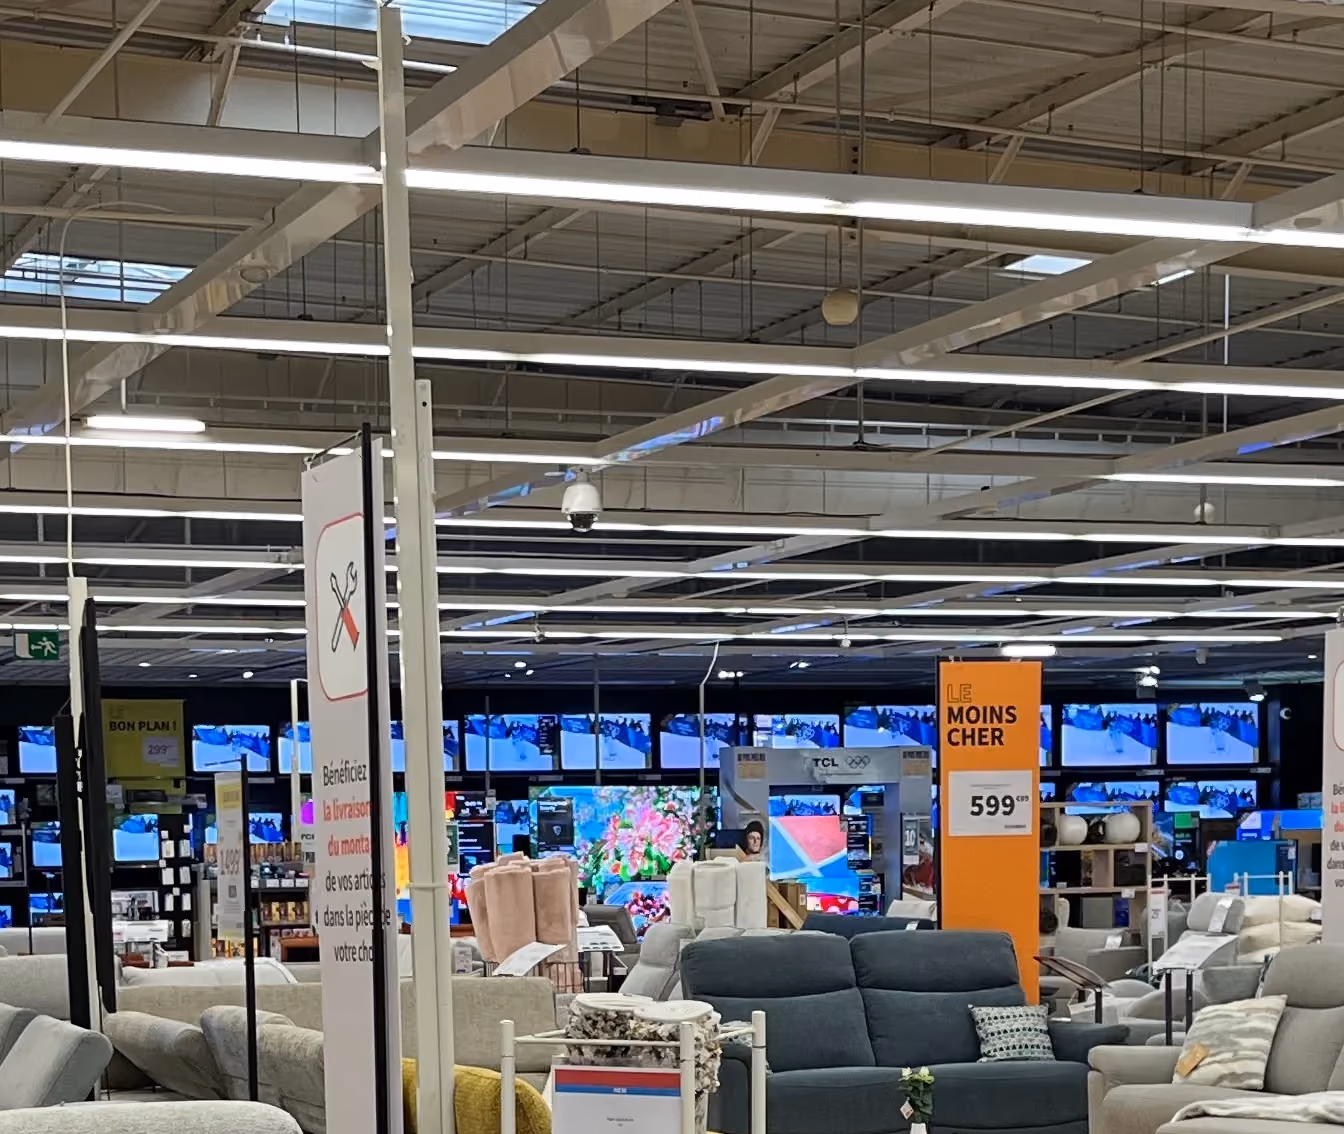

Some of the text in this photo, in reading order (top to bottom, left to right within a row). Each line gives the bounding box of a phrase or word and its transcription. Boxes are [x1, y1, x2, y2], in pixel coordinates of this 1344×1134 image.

[947, 683, 972, 703] LE
[947, 705, 1017, 724] MOINS
[109, 721, 170, 731] BON PLAN
[947, 727, 1004, 747] CHER
[323, 759, 367, 787] Bénéficiez
[812, 757, 839, 768] TCL
[323, 800, 331, 821] la
[328, 834, 370, 857] du monta
[325, 868, 386, 891] de vos artics
[323, 900, 374, 932] dans la pièc
[334, 939, 373, 962] votre cho
